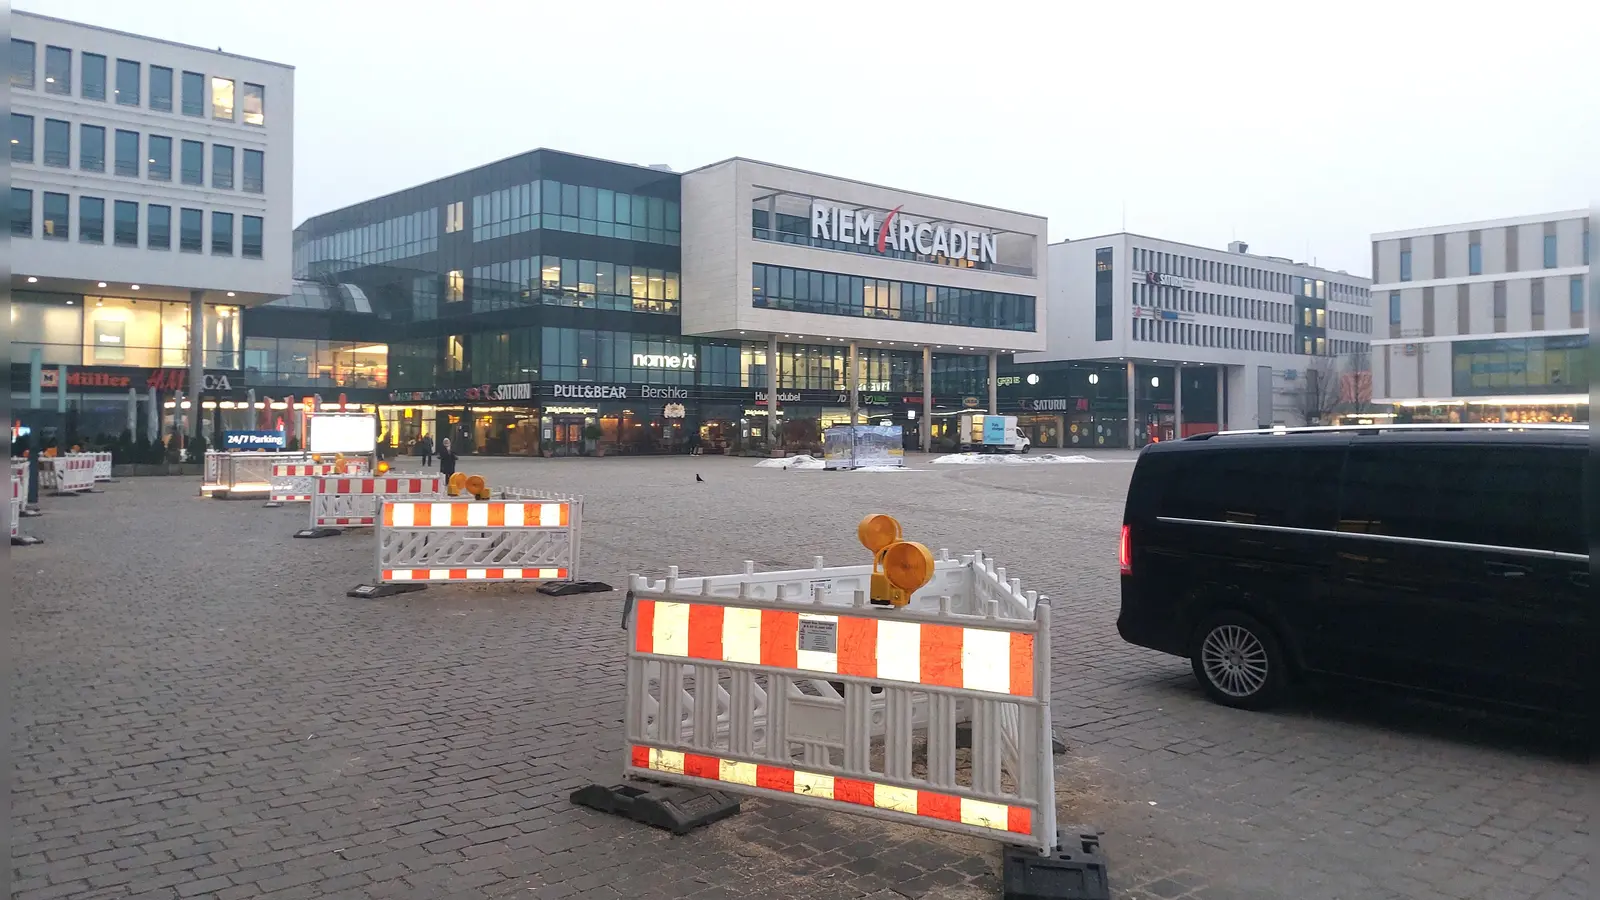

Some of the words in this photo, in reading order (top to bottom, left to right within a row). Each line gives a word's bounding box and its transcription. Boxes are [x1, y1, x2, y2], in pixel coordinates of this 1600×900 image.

[811, 203, 875, 247] RIEM
[877, 204, 997, 264] ARCADEN
[1159, 274, 1183, 288] SATURN
[633, 354, 681, 368] name
[682, 352, 697, 369] it
[202, 375, 232, 390] C&A
[497, 383, 531, 400] SATURN
[554, 384, 627, 398] PULL&BEAR
[641, 384, 688, 399] Bershka
[837, 394, 847, 403] JD
[1033, 399, 1067, 411] SATURN
[227, 434, 249, 444] 24/7
[250, 434, 283, 445] Parking
